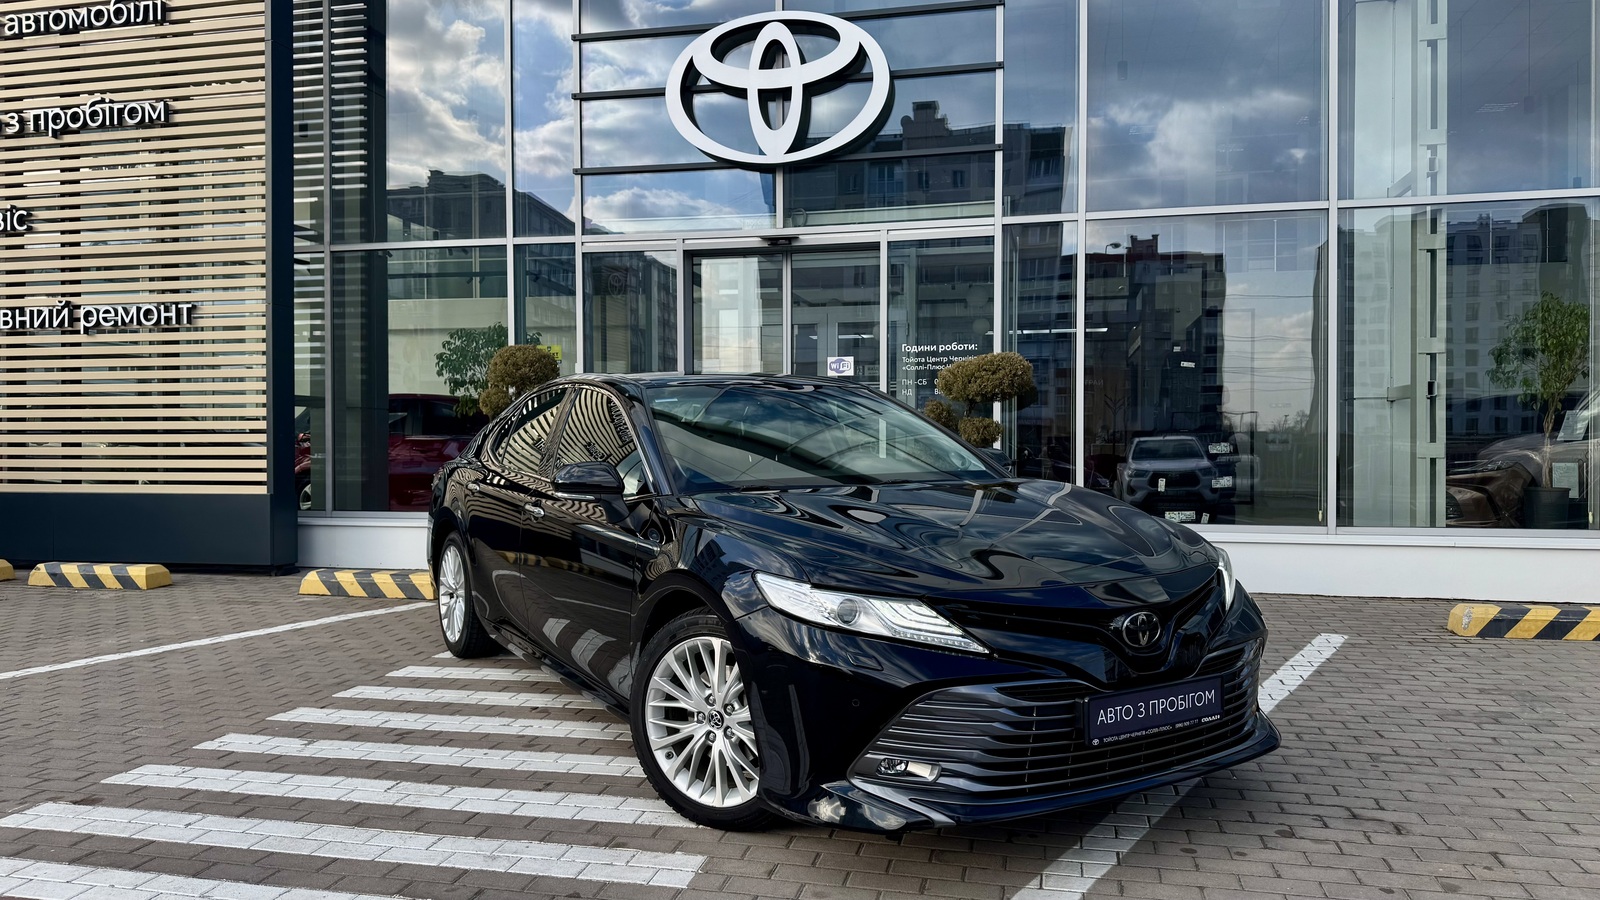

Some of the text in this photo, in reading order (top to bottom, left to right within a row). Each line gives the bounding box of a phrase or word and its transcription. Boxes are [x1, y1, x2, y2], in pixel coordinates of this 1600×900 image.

[4, 0, 163, 35] автомобілі
[6, 97, 165, 137] з пробігом
[0, 300, 193, 334] вний ремонт
[901, 342, 978, 353] Години роботи:
[901, 388, 912, 396] НД
[1097, 704, 1134, 725] АВТО
[1149, 689, 1215, 716] ПРОБІГОМ
